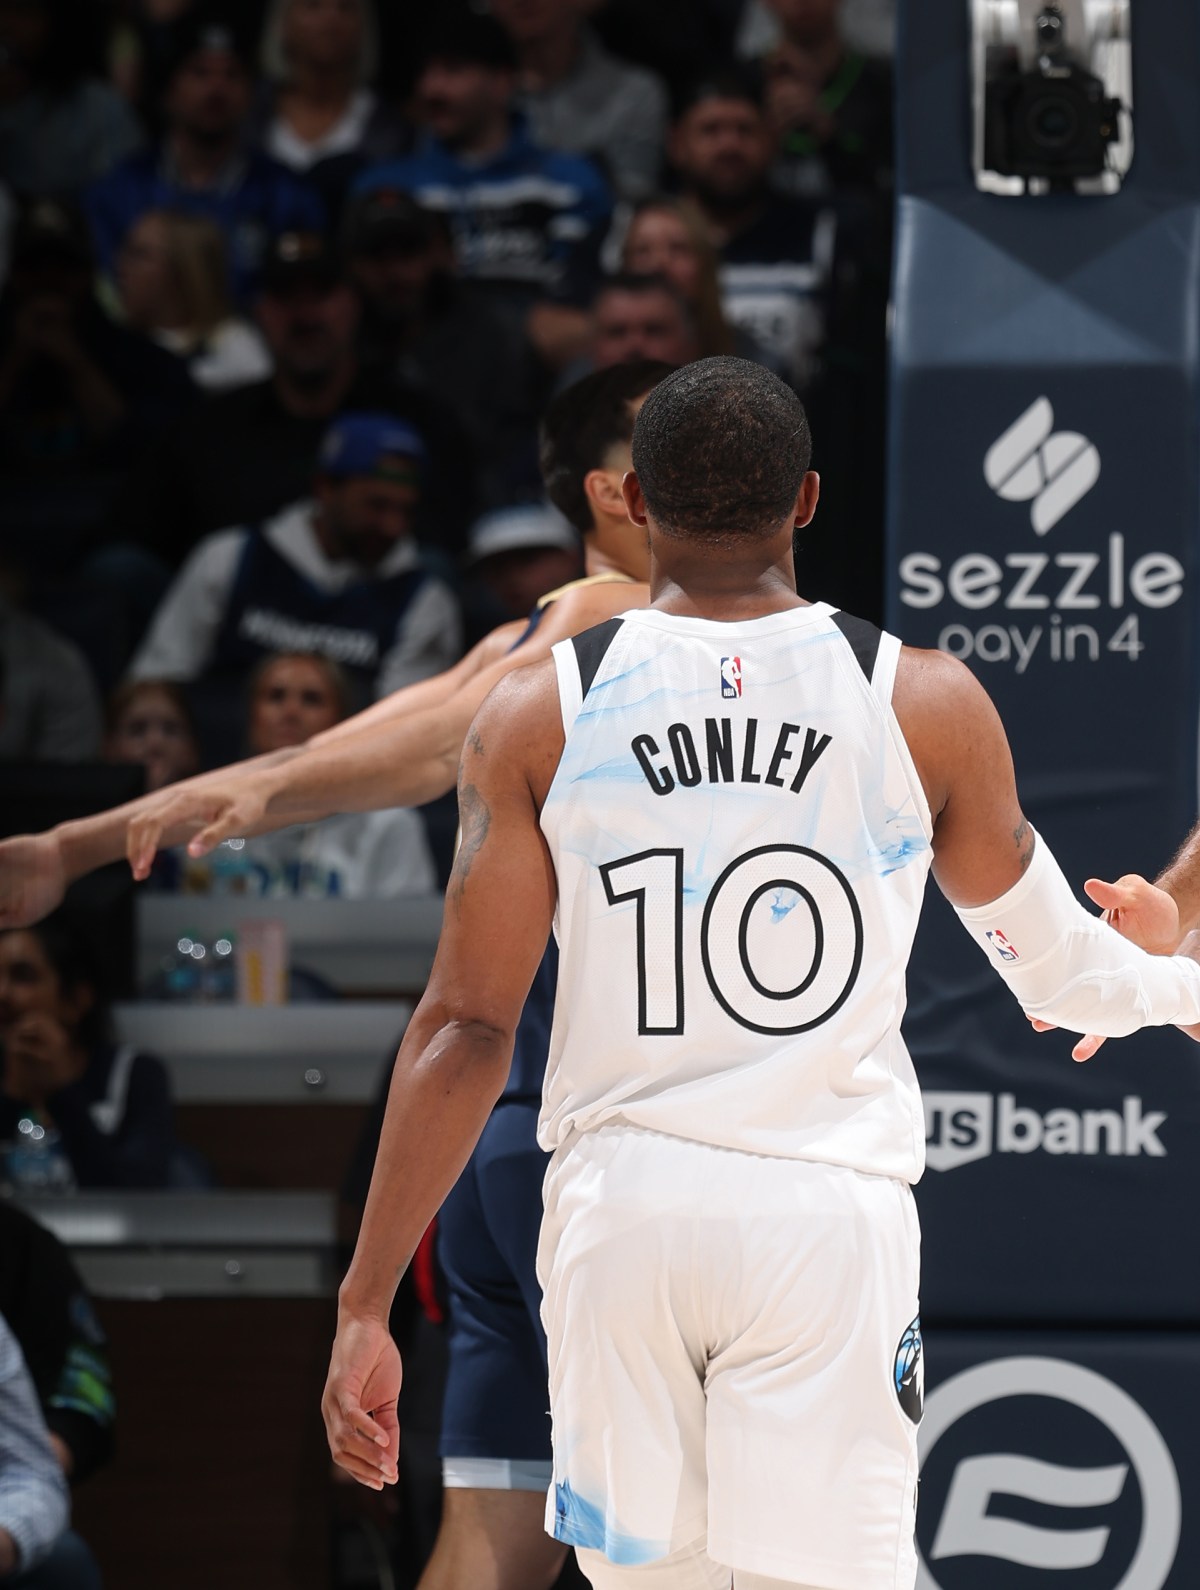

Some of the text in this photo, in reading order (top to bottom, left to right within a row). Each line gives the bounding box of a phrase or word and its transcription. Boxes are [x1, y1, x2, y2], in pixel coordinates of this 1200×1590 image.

[900, 532, 1185, 609] sezzle
[938, 613, 1145, 674] pay in 4
[631, 718, 833, 796] CONLEY
[599, 843, 864, 1036] 10
[998, 1092, 1168, 1157] bank
